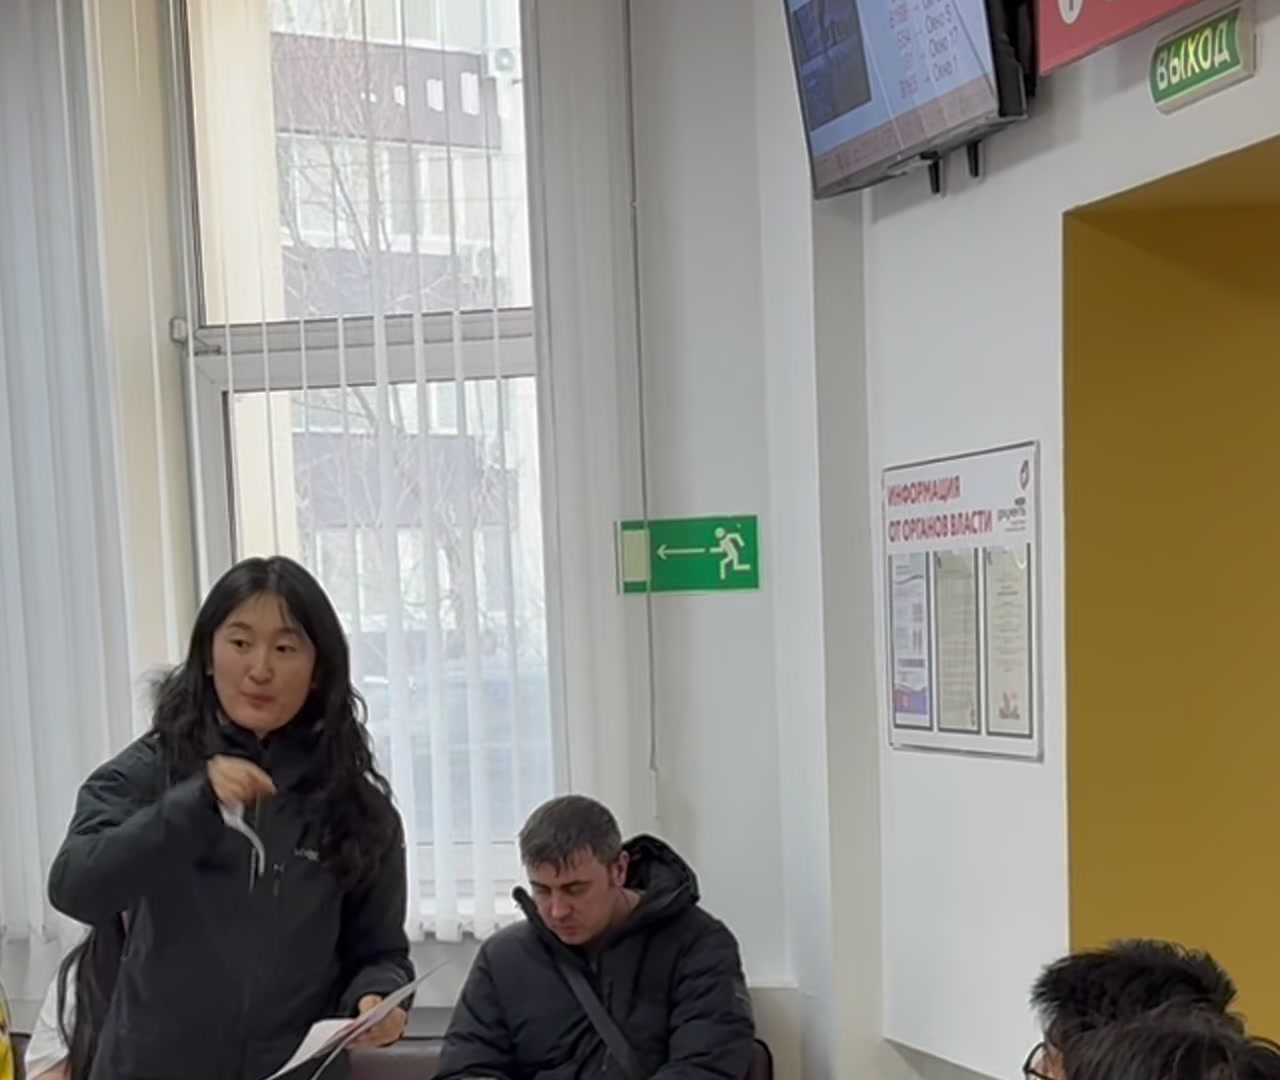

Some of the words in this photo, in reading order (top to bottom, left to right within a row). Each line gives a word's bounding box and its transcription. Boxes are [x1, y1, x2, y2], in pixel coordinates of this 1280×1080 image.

[1157, 20, 1231, 91] ВЫХОД
[888, 475, 960, 507] ИНФОРМАЦИЯ
[888, 519, 901, 542] ОТ
[902, 513, 949, 541] ОРГАНОВ
[950, 509, 993, 537] ВЛАСТИ
